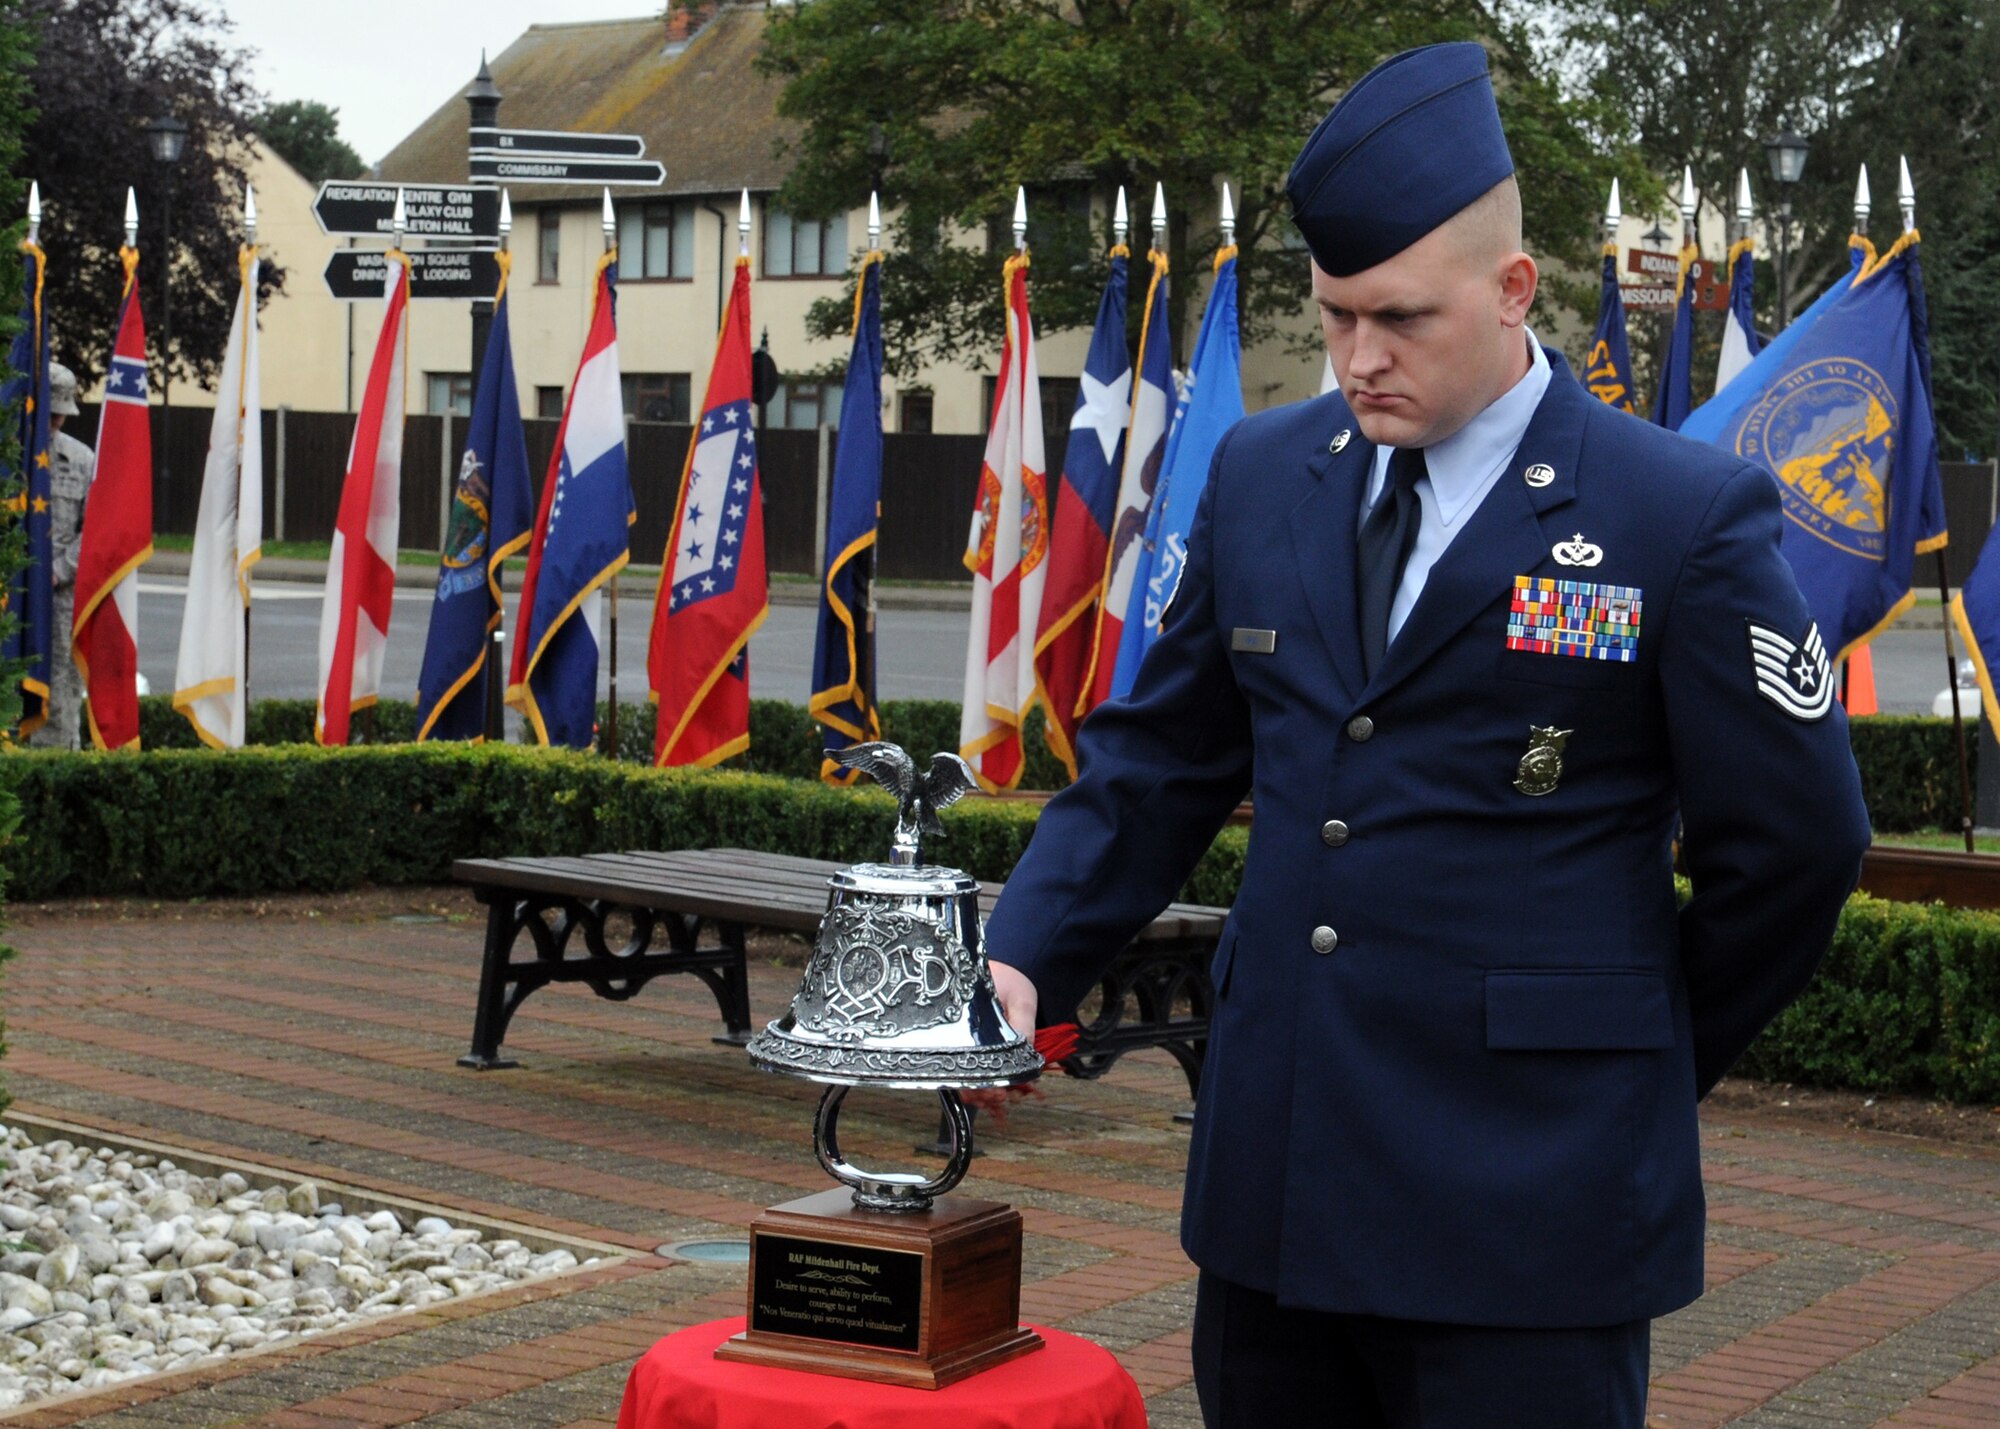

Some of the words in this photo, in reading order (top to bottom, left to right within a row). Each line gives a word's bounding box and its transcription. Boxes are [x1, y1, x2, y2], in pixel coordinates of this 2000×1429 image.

[497, 163, 568, 176] COMMISSARY
[326, 187, 396, 202] RECREATION
[448, 192, 473, 204] GYM
[404, 203, 443, 217] ALAXY
[443, 205, 474, 219] CLUB
[443, 221, 473, 233] HALL
[427, 254, 471, 266] SQUARE
[423, 268, 472, 281] LODGING
[788, 1252, 804, 1264] RAF
[805, 1254, 845, 1269] Mildenhall
[846, 1259, 861, 1271] Fire
[862, 1262, 881, 1275] Dept.
[775, 1279, 799, 1292] Desire
[800, 1284, 808, 1293] to
[808, 1286, 829, 1297] serve,
[829, 1286, 851, 1301] ability
[852, 1291, 860, 1299] to
[861, 1291, 893, 1305] perform,
[808, 1300, 837, 1313] courage
[838, 1303, 846, 1312] to
[846, 1305, 857, 1313] act
[779, 1306, 812, 1320] Veneratio
[812, 1312, 825, 1324] qui
[825, 1315, 844, 1325] servo
[845, 1317, 864, 1328] quod
